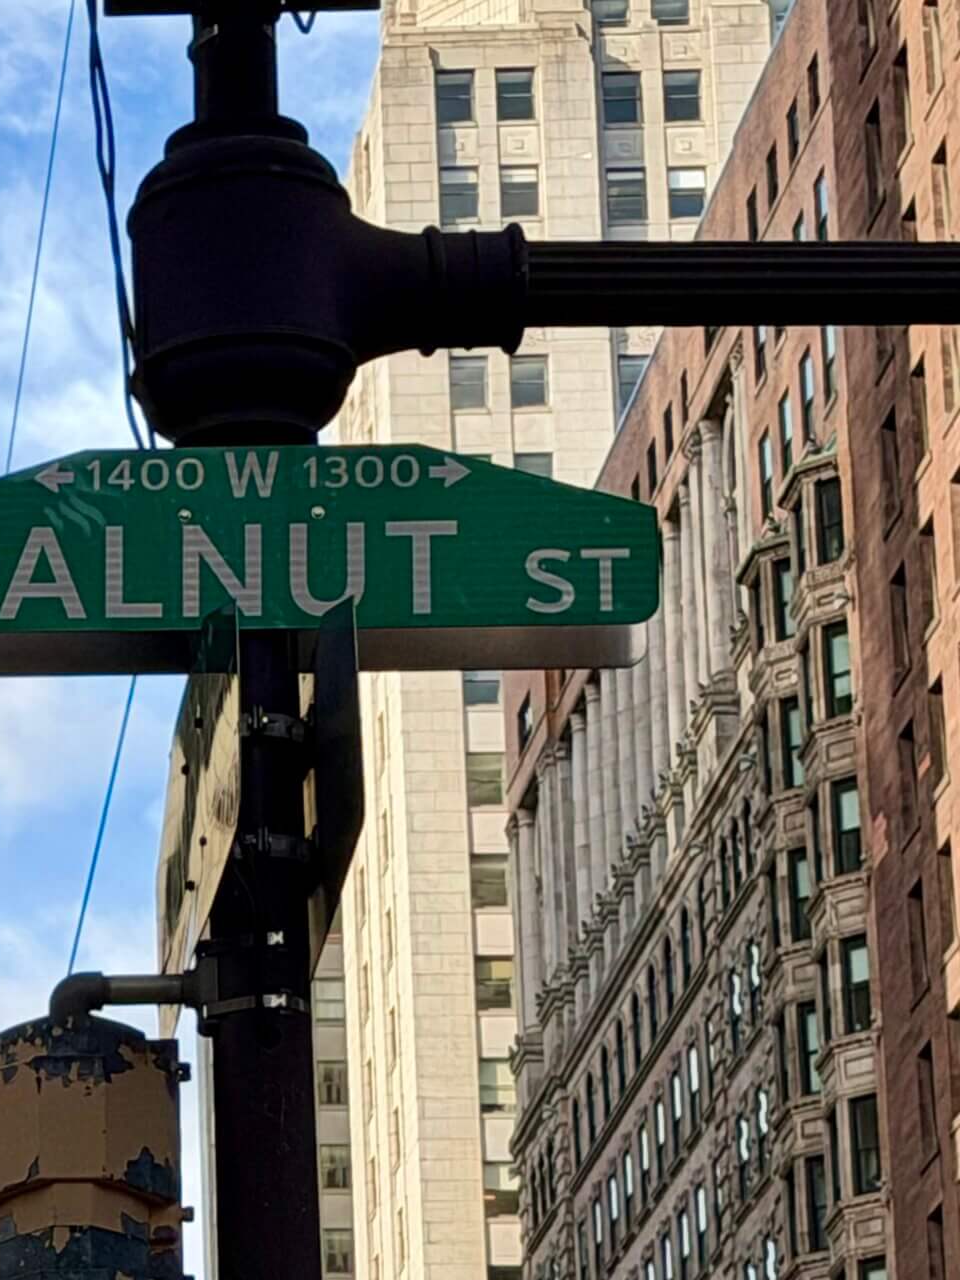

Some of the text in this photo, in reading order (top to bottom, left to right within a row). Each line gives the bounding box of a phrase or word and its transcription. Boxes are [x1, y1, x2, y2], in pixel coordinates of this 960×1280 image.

[86, 450, 420, 498] 1400 W 1300
[525, 548, 631, 613] ST
